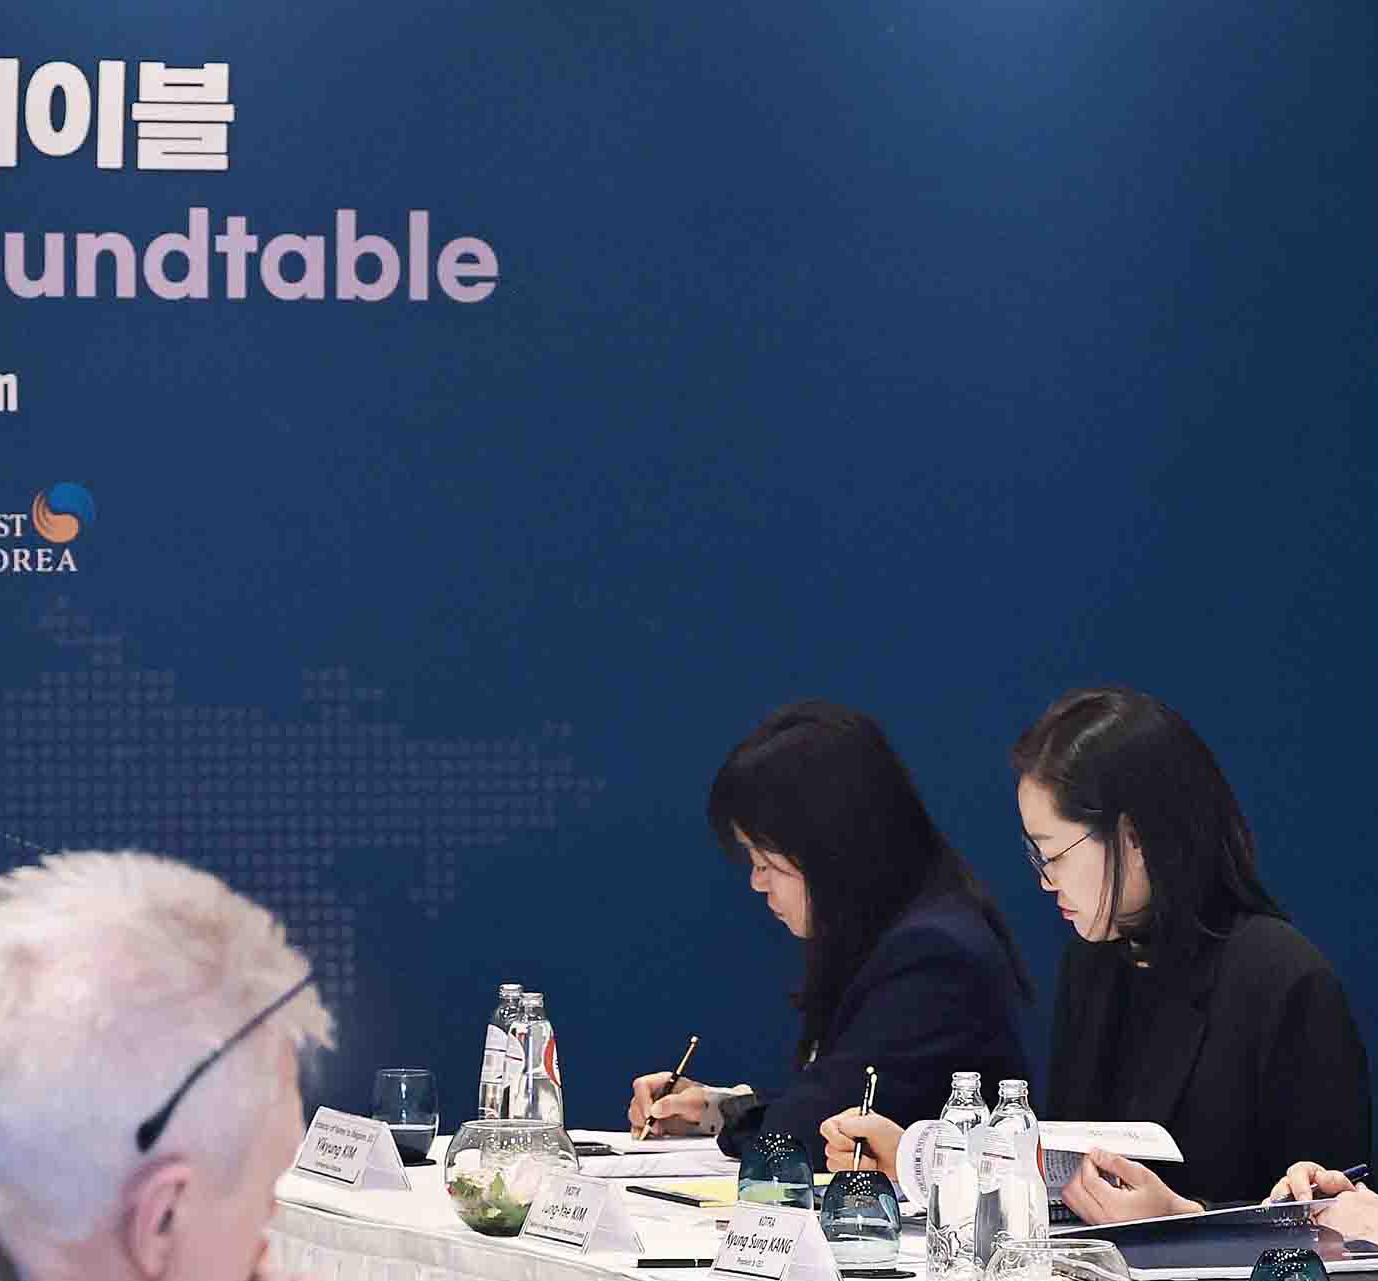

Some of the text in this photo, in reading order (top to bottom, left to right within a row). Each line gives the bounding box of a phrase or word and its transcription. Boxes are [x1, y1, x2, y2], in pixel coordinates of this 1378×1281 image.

[725, 1230, 794, 1255] Kyung Sung KANG
